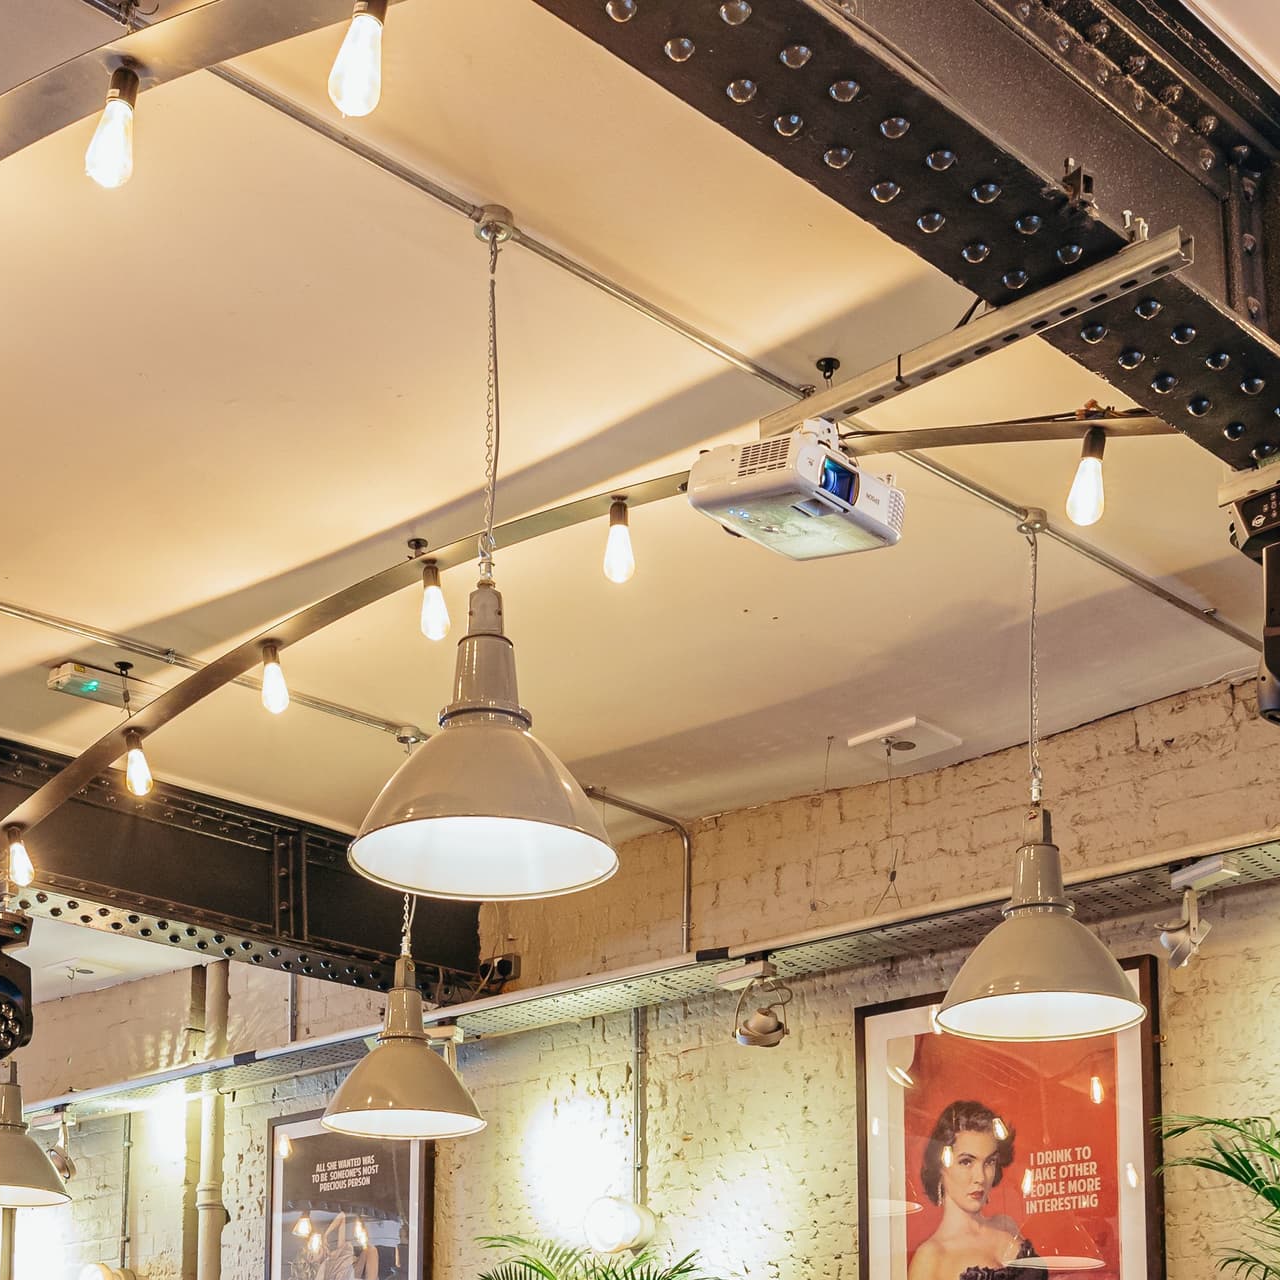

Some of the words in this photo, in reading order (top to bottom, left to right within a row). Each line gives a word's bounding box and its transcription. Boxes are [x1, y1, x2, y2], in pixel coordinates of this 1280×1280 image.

[316, 1163, 325, 1173] ALL
[327, 1160, 337, 1171] SHE
[338, 1157, 361, 1169] WANTED
[362, 1154, 375, 1165] WAS
[1030, 1152, 1035, 1167] I
[1037, 1148, 1072, 1165] DRINK
[1075, 1145, 1091, 1160] TO
[312, 1174, 319, 1183] TO
[321, 1172, 328, 1182] BE
[330, 1167, 361, 1181] SOMEONE'S
[363, 1164, 379, 1175] MOST
[1059, 1161, 1097, 1179] OTHER
[320, 1180, 347, 1192] PRECIOUS
[348, 1176, 370, 1188] PERSON
[1023, 1180, 1065, 1199] EOPLE
[1068, 1177, 1101, 1194] MORE
[1025, 1193, 1099, 1215] INTERESTING
